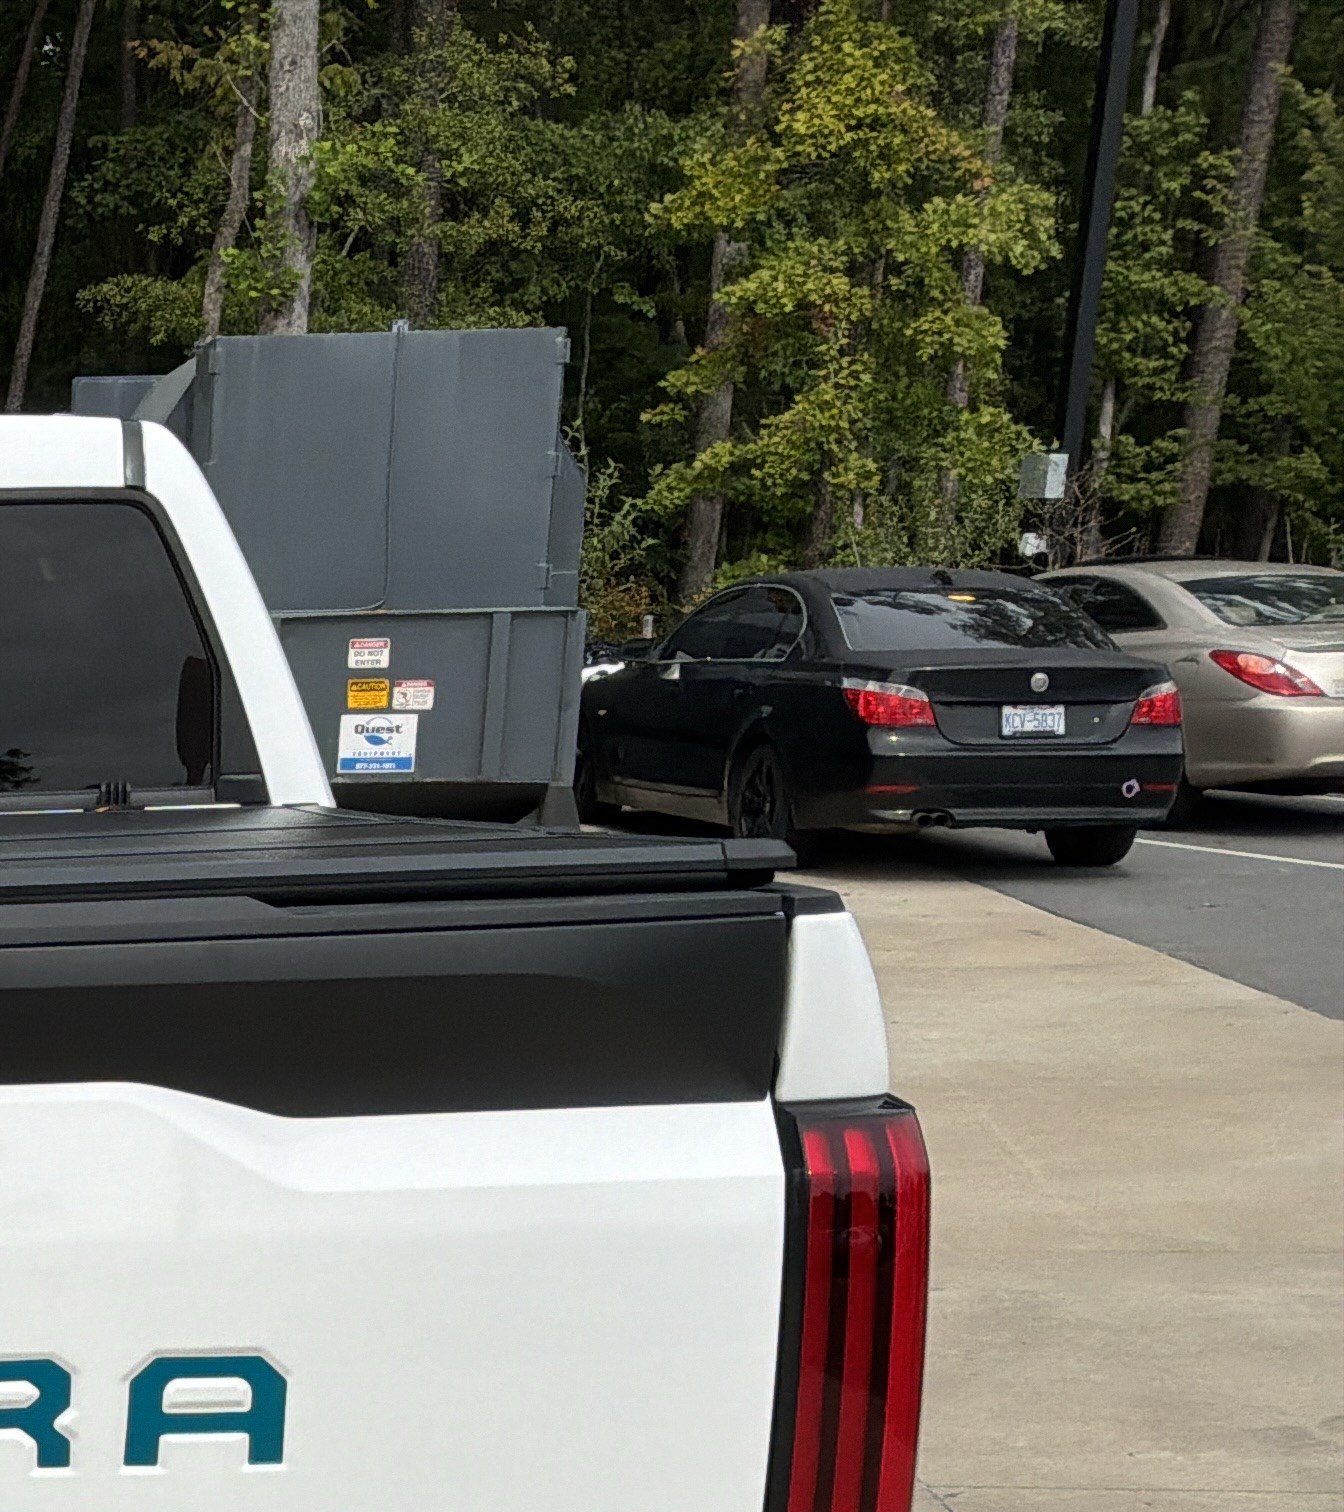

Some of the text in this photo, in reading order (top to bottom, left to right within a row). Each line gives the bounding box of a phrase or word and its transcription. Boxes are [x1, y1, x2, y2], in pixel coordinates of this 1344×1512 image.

[354, 658, 382, 666] ENTER
[356, 682, 386, 690] CAUTION
[354, 723, 403, 735] Quest
